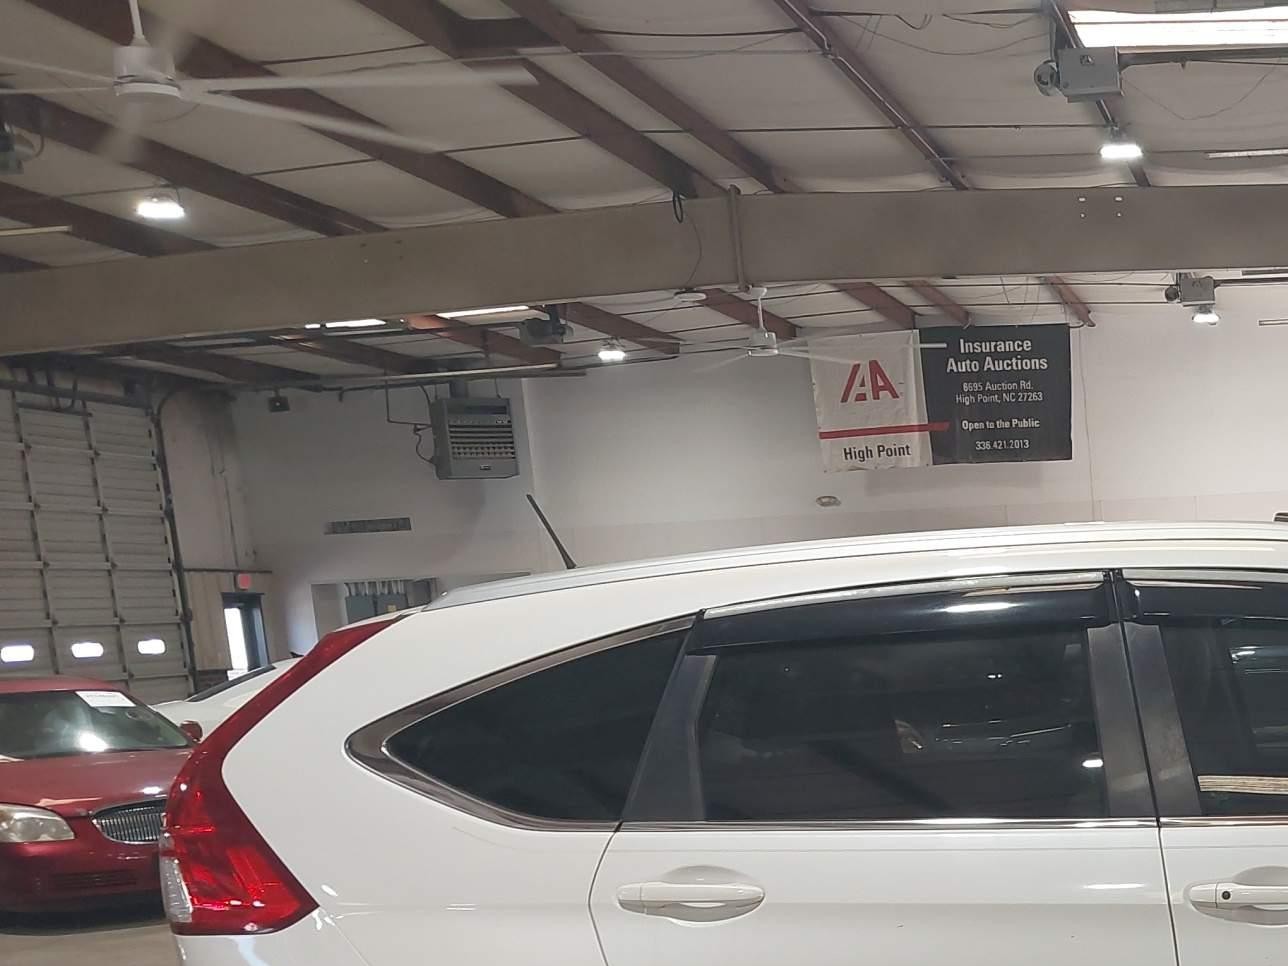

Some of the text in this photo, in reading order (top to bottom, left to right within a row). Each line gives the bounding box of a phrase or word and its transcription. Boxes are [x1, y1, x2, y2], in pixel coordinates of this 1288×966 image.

[960, 339, 1032, 354] Insurance
[946, 356, 1048, 373] Auto Auctions
[985, 382, 1017, 391] Auction
[1019, 381, 1033, 390] Rd.
[956, 392, 1043, 405] High Point, NC 27263
[962, 419, 1040, 431] Open to the Public
[975, 439, 1029, 450] 336.421.2013
[843, 444, 911, 462] High Point
